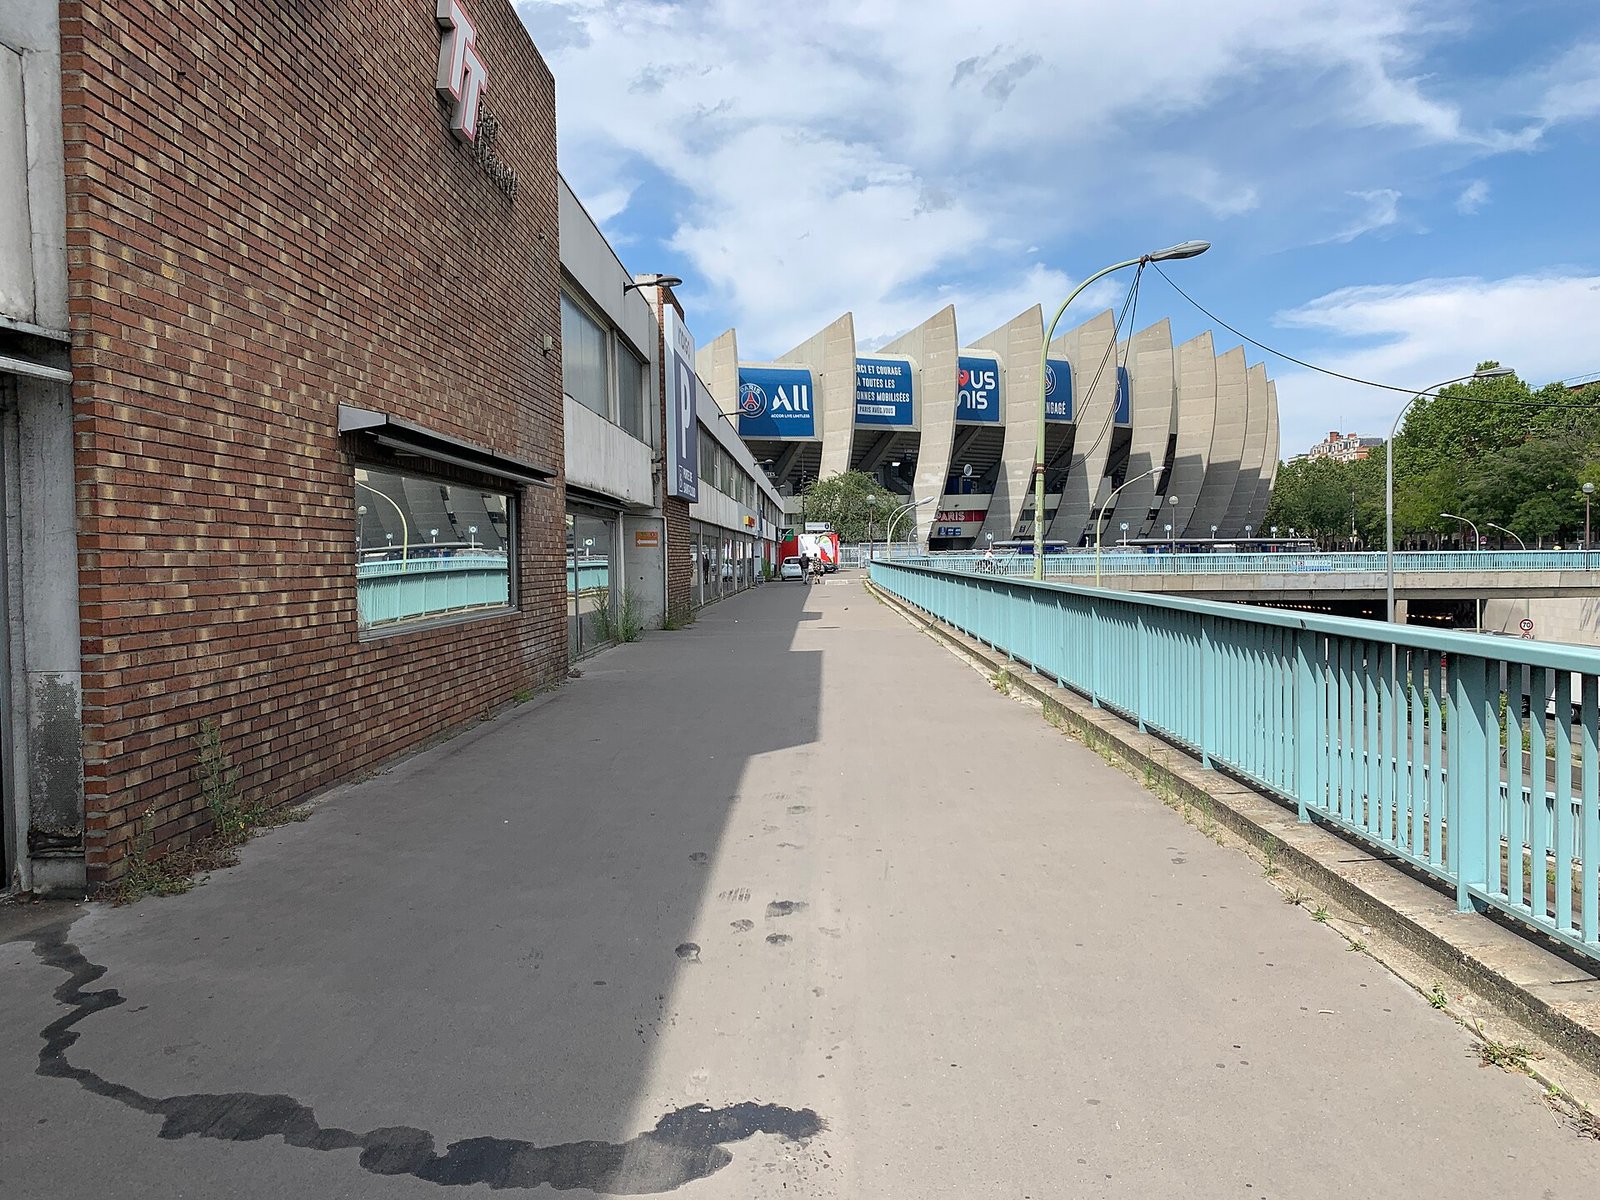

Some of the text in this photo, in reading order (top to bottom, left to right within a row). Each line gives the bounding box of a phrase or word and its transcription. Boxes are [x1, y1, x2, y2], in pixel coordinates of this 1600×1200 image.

[855, 364, 902, 376] RCI ET COURAGE
[862, 377, 884, 389] TOUTES
[884, 379, 896, 389] LES
[740, 384, 762, 395] PARIS
[876, 391, 910, 403] MOBILISÉES
[680, 362, 690, 459] P
[859, 406, 871, 414] PARIS
